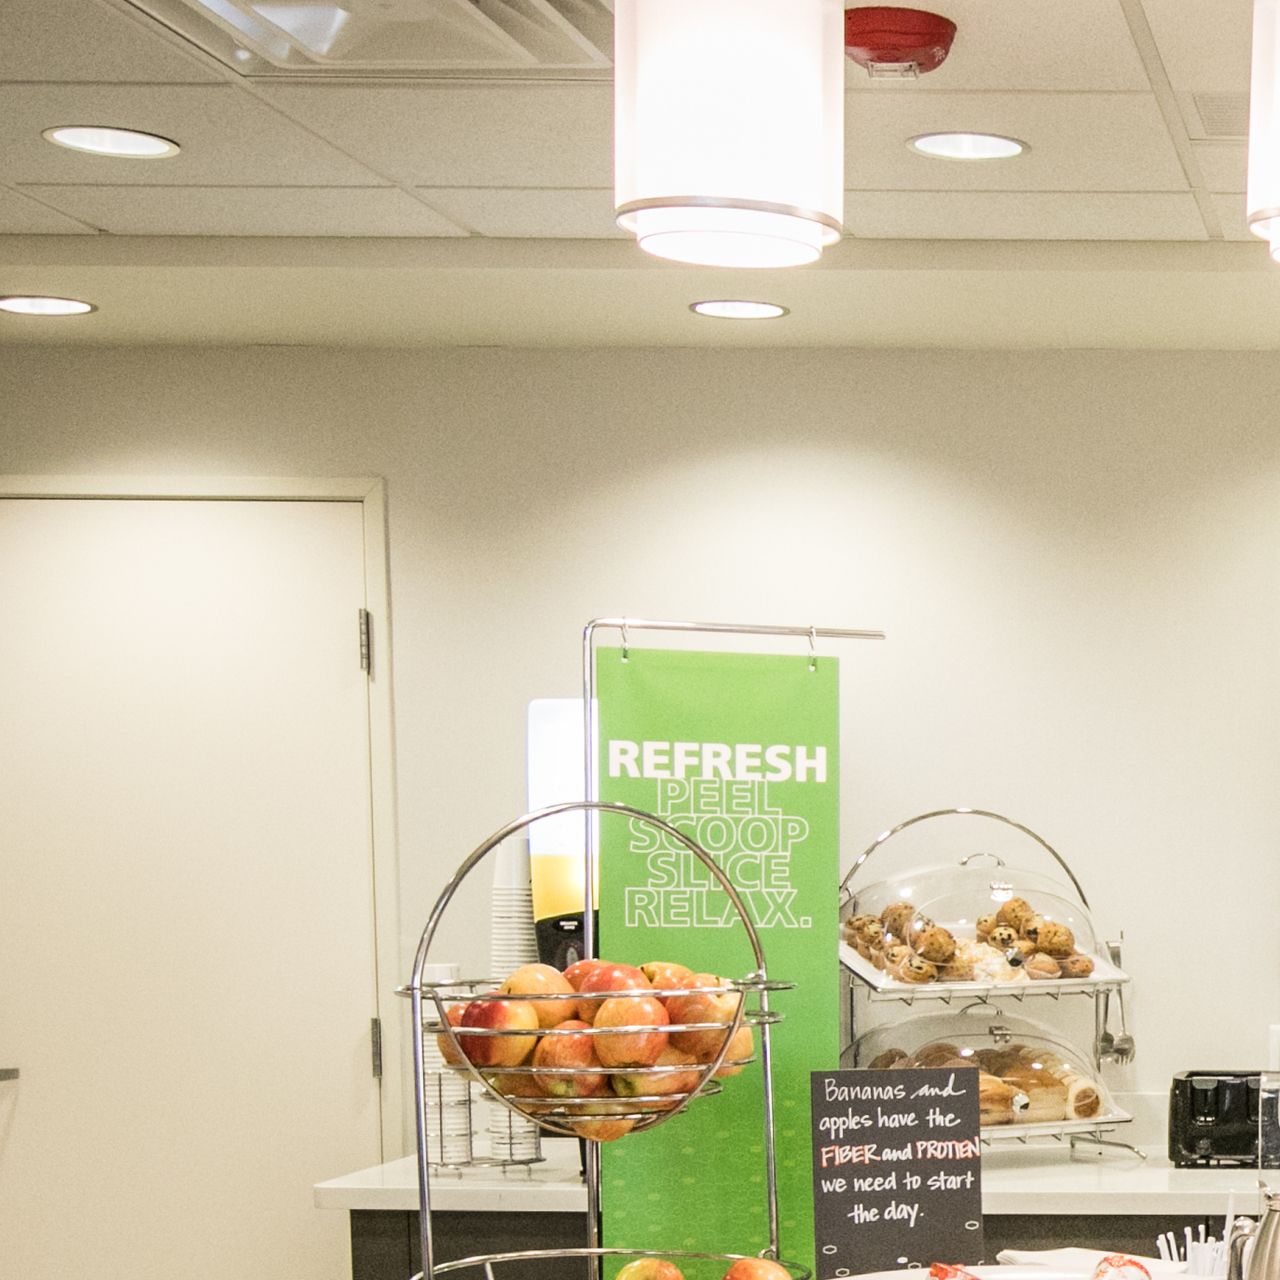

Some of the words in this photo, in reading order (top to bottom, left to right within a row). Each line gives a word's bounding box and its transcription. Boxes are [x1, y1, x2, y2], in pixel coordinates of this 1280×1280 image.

[608, 740, 827, 783] REFRESH
[657, 777, 782, 816] PEEL
[629, 813, 809, 855] SCOOP
[647, 851, 791, 891] SLICE
[625, 886, 812, 928] RELAX.
[825, 1078, 906, 1101] Bananas
[910, 1073, 966, 1099] and
[819, 1107, 873, 1140] apples
[878, 1107, 918, 1128] have
[926, 1107, 961, 1128] the
[820, 1143, 881, 1168] FIBER
[882, 1143, 912, 1161] and
[916, 1136, 981, 1160] PROTIEN
[821, 1178, 847, 1193] we
[853, 1171, 896, 1192] need
[902, 1171, 921, 1190] to
[927, 1171, 974, 1190] start
[847, 1203, 880, 1224] the
[884, 1201, 924, 1227] day.
